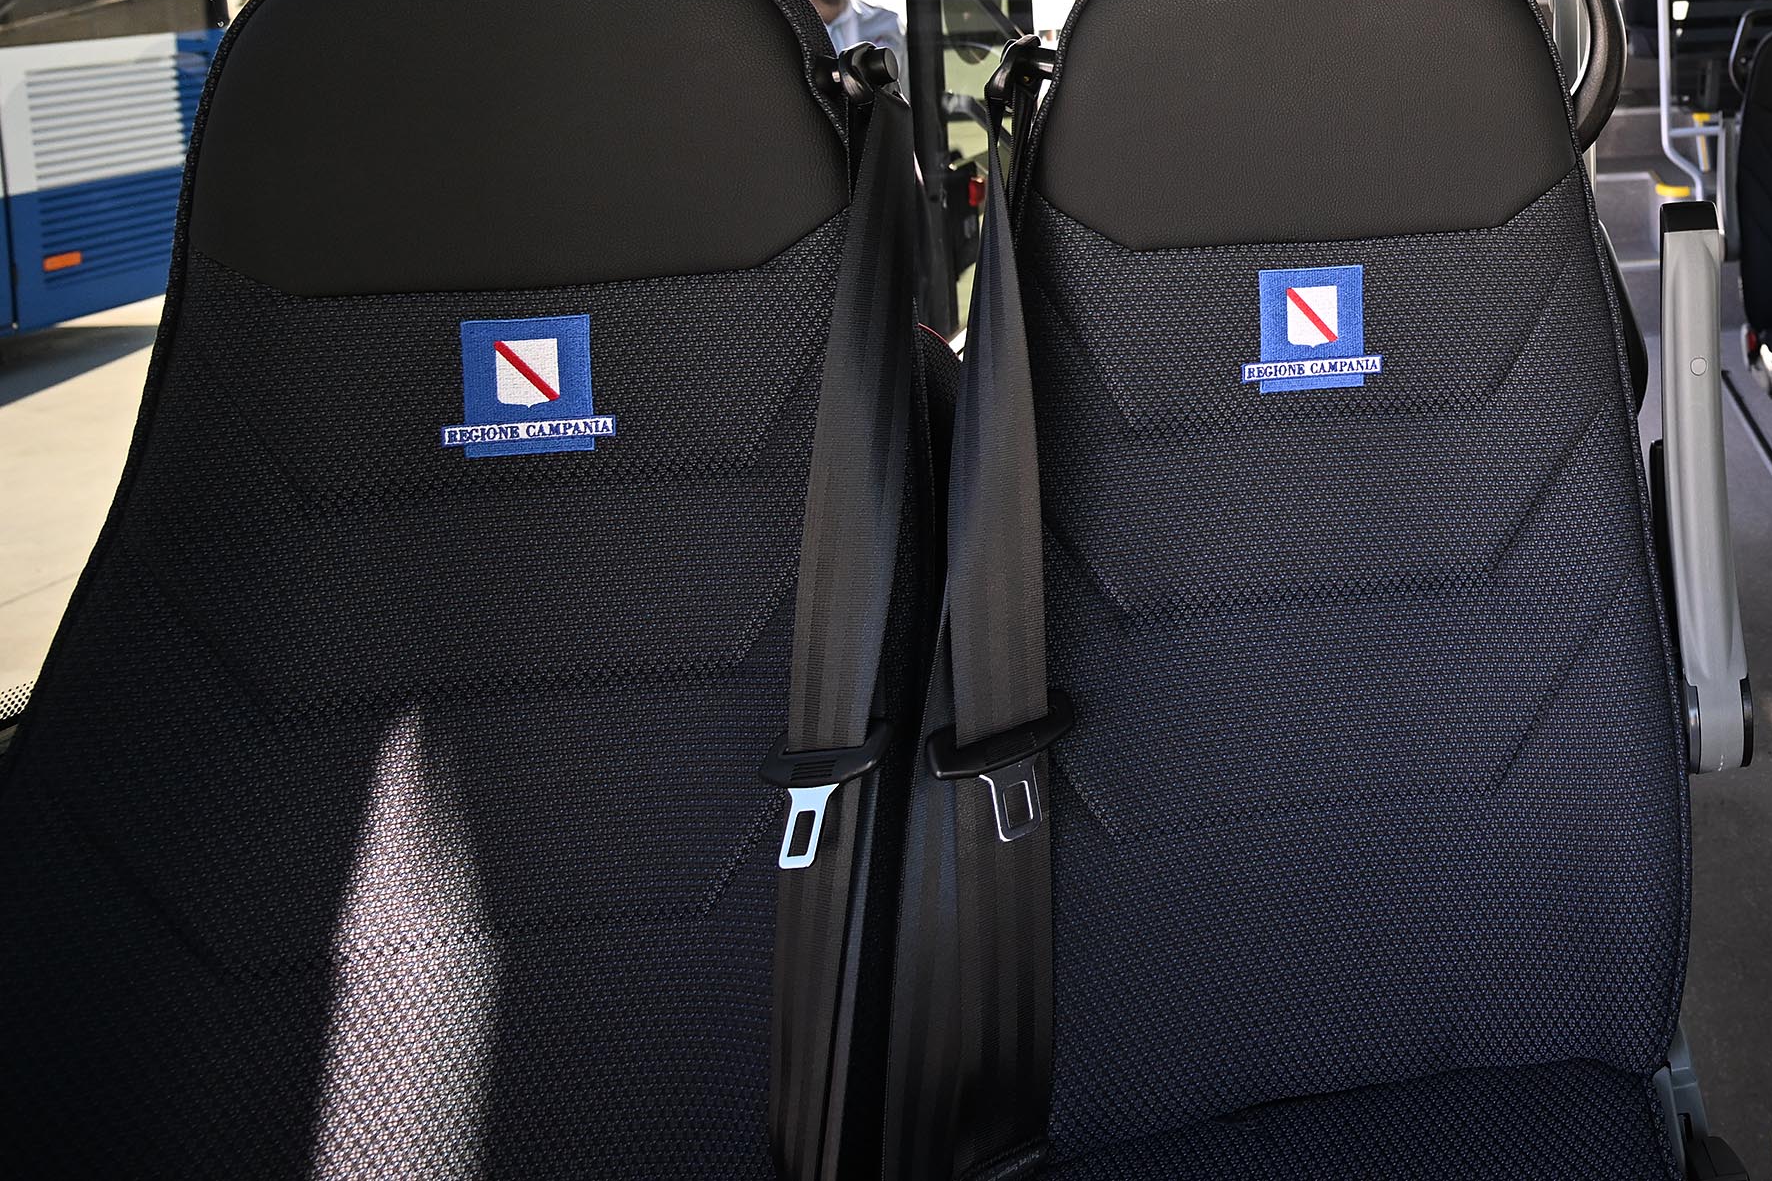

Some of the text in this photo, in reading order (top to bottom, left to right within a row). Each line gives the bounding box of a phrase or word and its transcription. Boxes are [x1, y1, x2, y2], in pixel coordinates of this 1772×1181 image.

[1246, 358, 1378, 379] REGIONE CAMPANIA
[447, 419, 612, 445] REGIONE CAMPANIA
